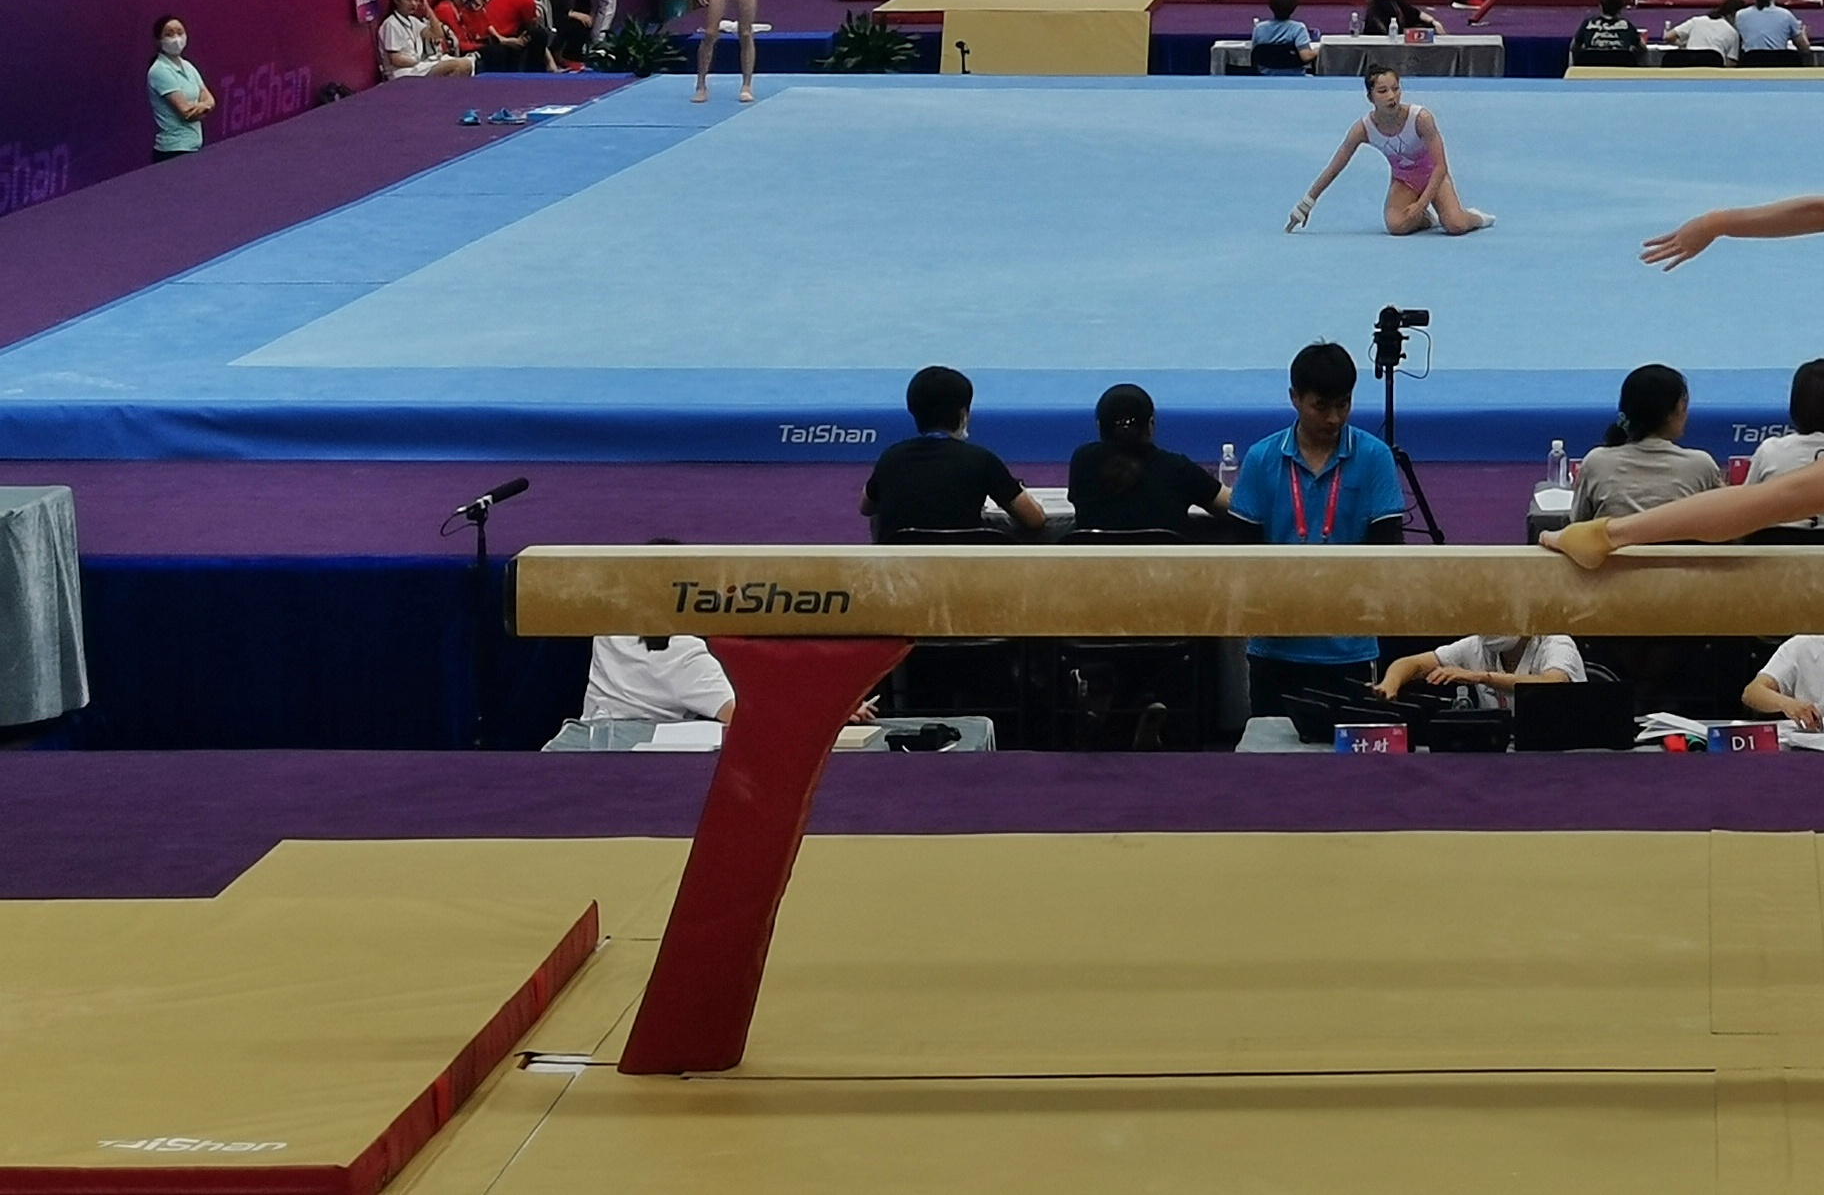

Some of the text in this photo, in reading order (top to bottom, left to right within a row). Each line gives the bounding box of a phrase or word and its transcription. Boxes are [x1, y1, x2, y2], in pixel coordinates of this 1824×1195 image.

[220, 62, 312, 136] TaiShan
[779, 424, 877, 444] TaiShan
[672, 581, 850, 614] TaiShan
[1351, 737, 1389, 753] 计时
[1731, 735, 1756, 751] D1
[97, 1137, 289, 1152] TaiShan
